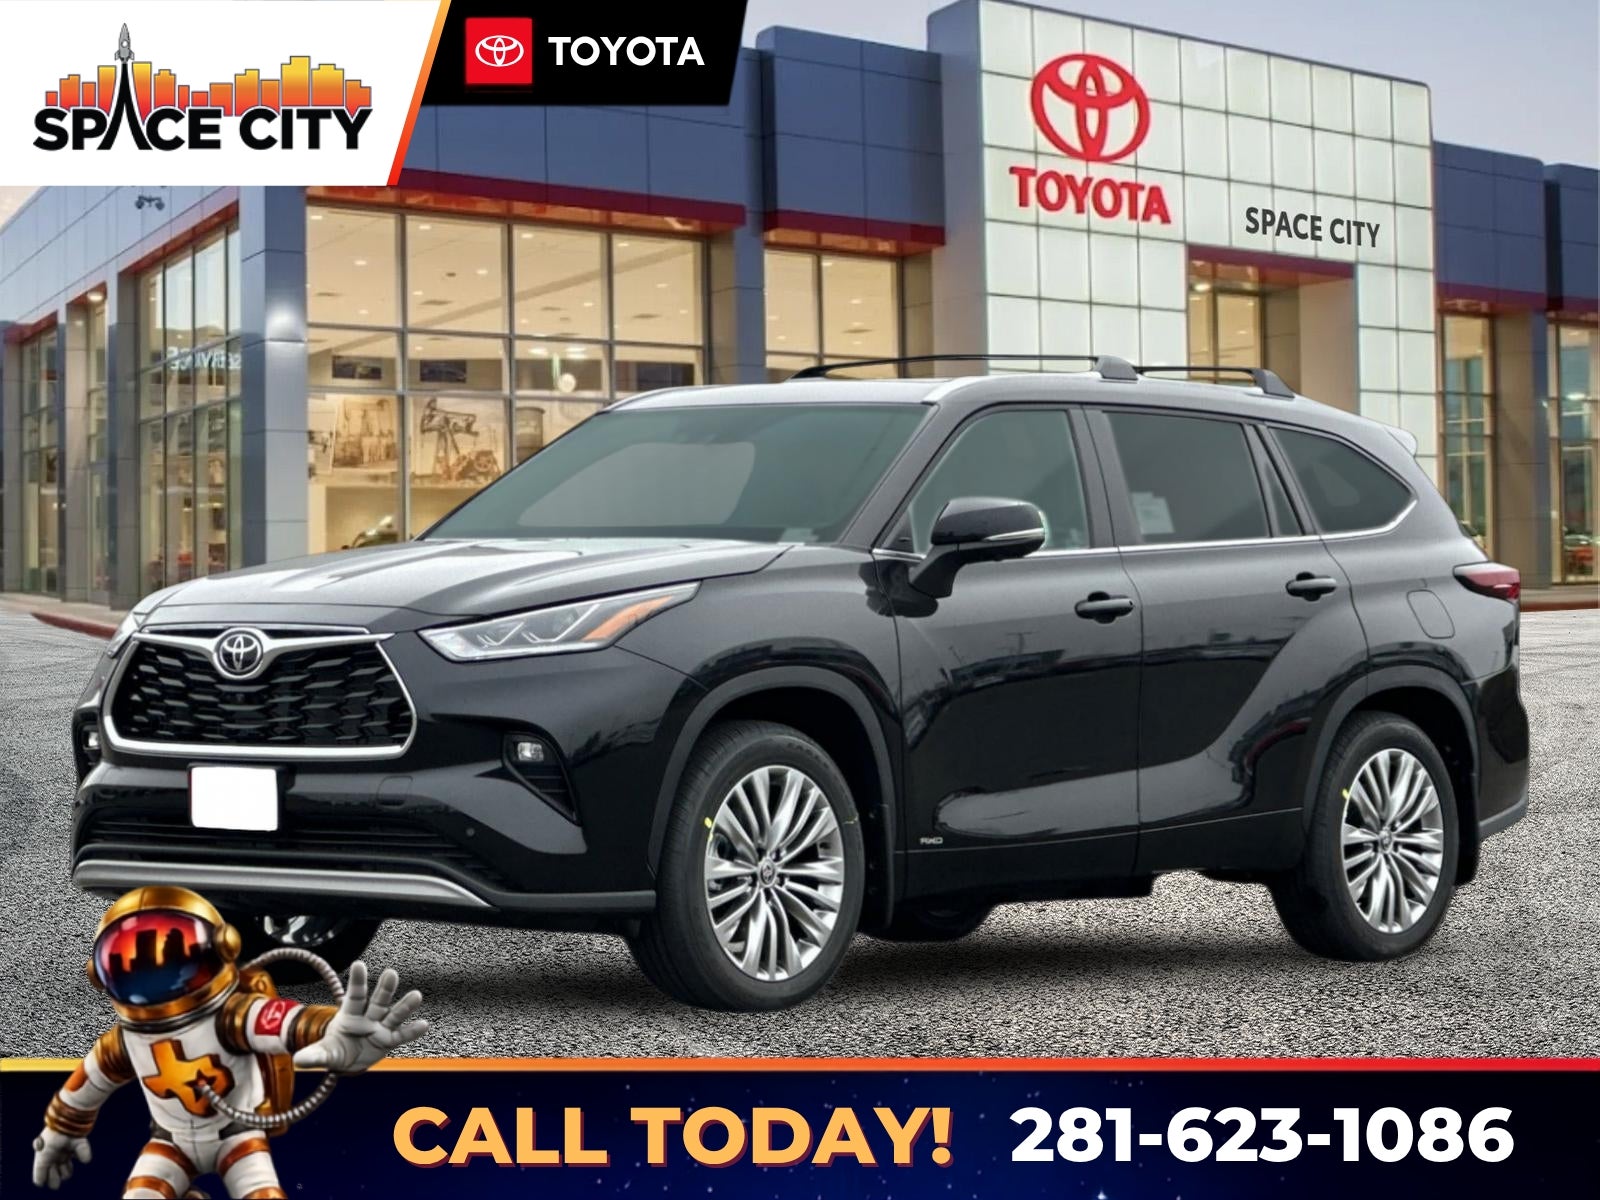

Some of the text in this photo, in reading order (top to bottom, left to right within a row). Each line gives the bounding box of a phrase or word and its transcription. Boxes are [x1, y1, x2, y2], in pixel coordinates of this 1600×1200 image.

[1009, 166, 1171, 224] TOYOTA
[1245, 207, 1381, 248] SPACE CITY
